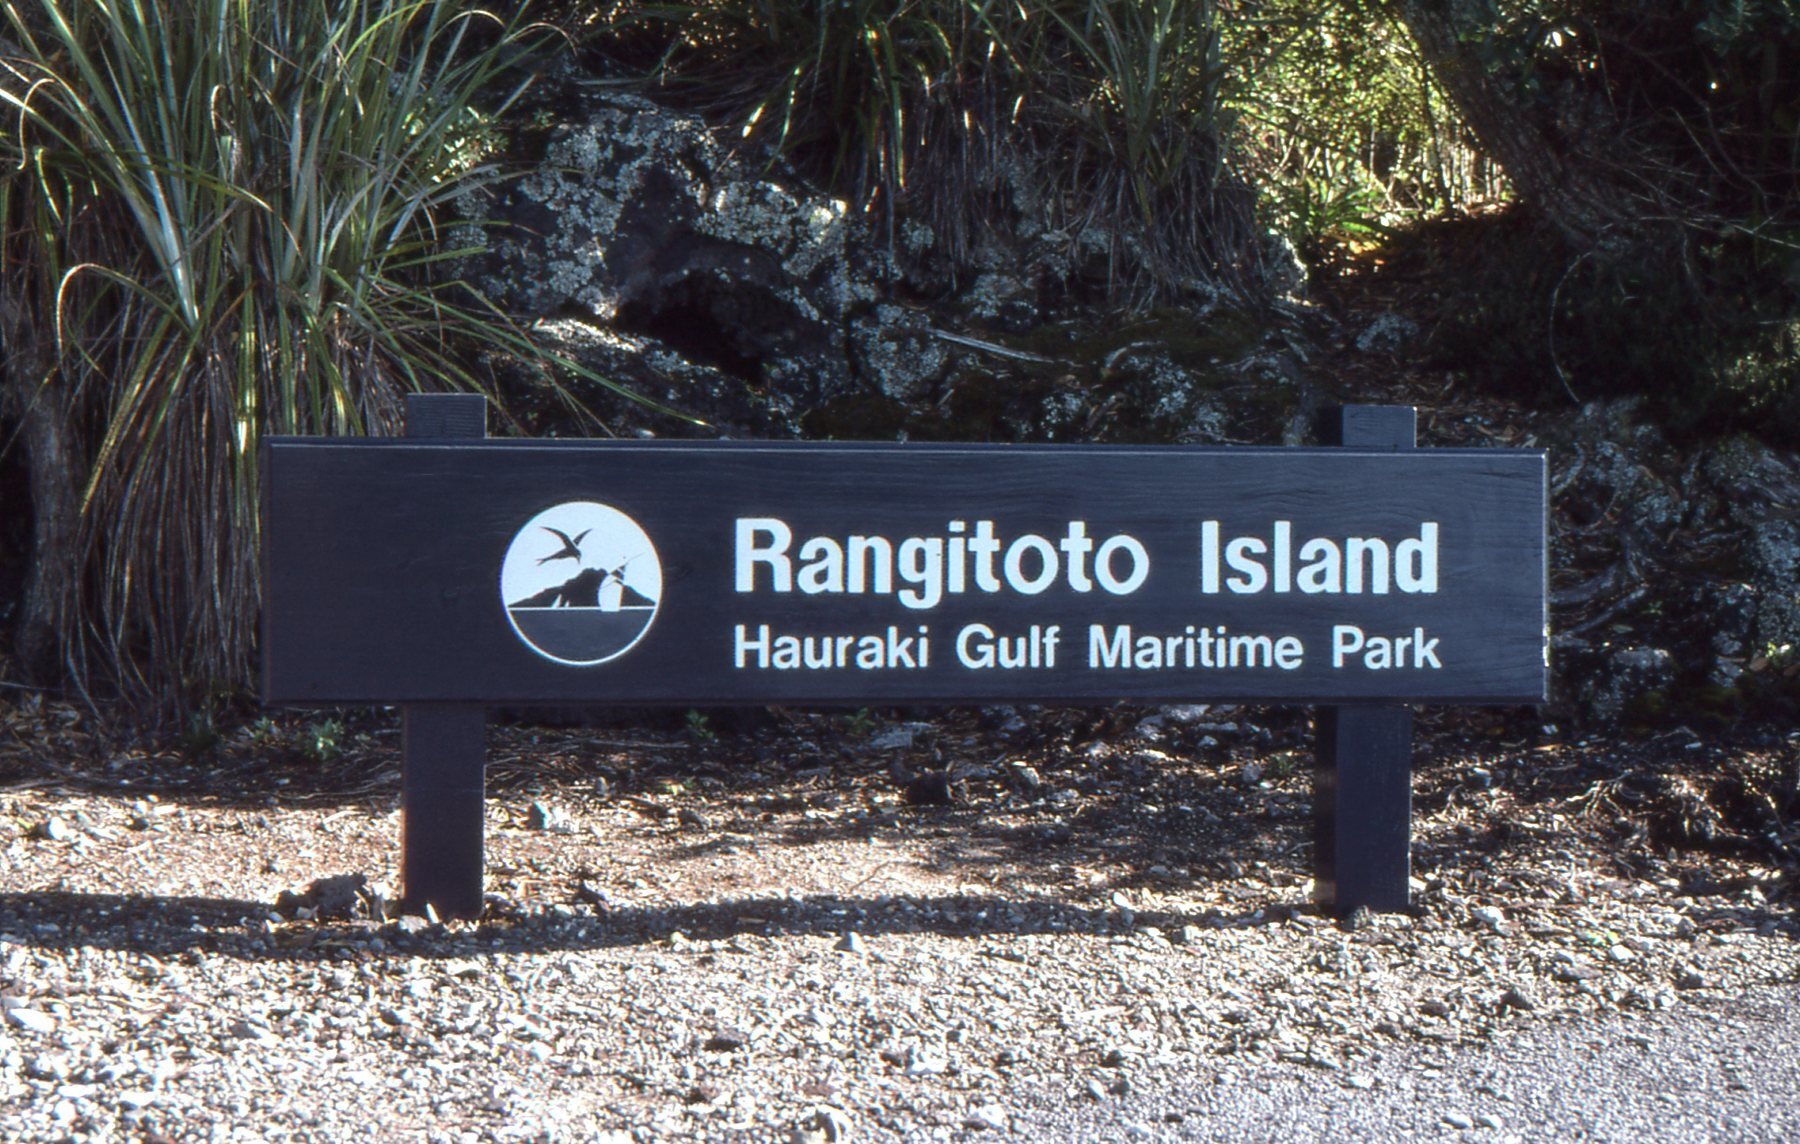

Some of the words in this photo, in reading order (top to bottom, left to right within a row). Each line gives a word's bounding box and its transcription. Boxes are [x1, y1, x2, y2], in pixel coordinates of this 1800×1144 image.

[735, 518, 1150, 610] Rangitoto
[1201, 520, 1439, 595] Island
[734, 624, 929, 670] Hauraki
[956, 623, 1061, 670] Gulf
[1088, 624, 1304, 670] Maritime
[1332, 624, 1442, 670] Park
